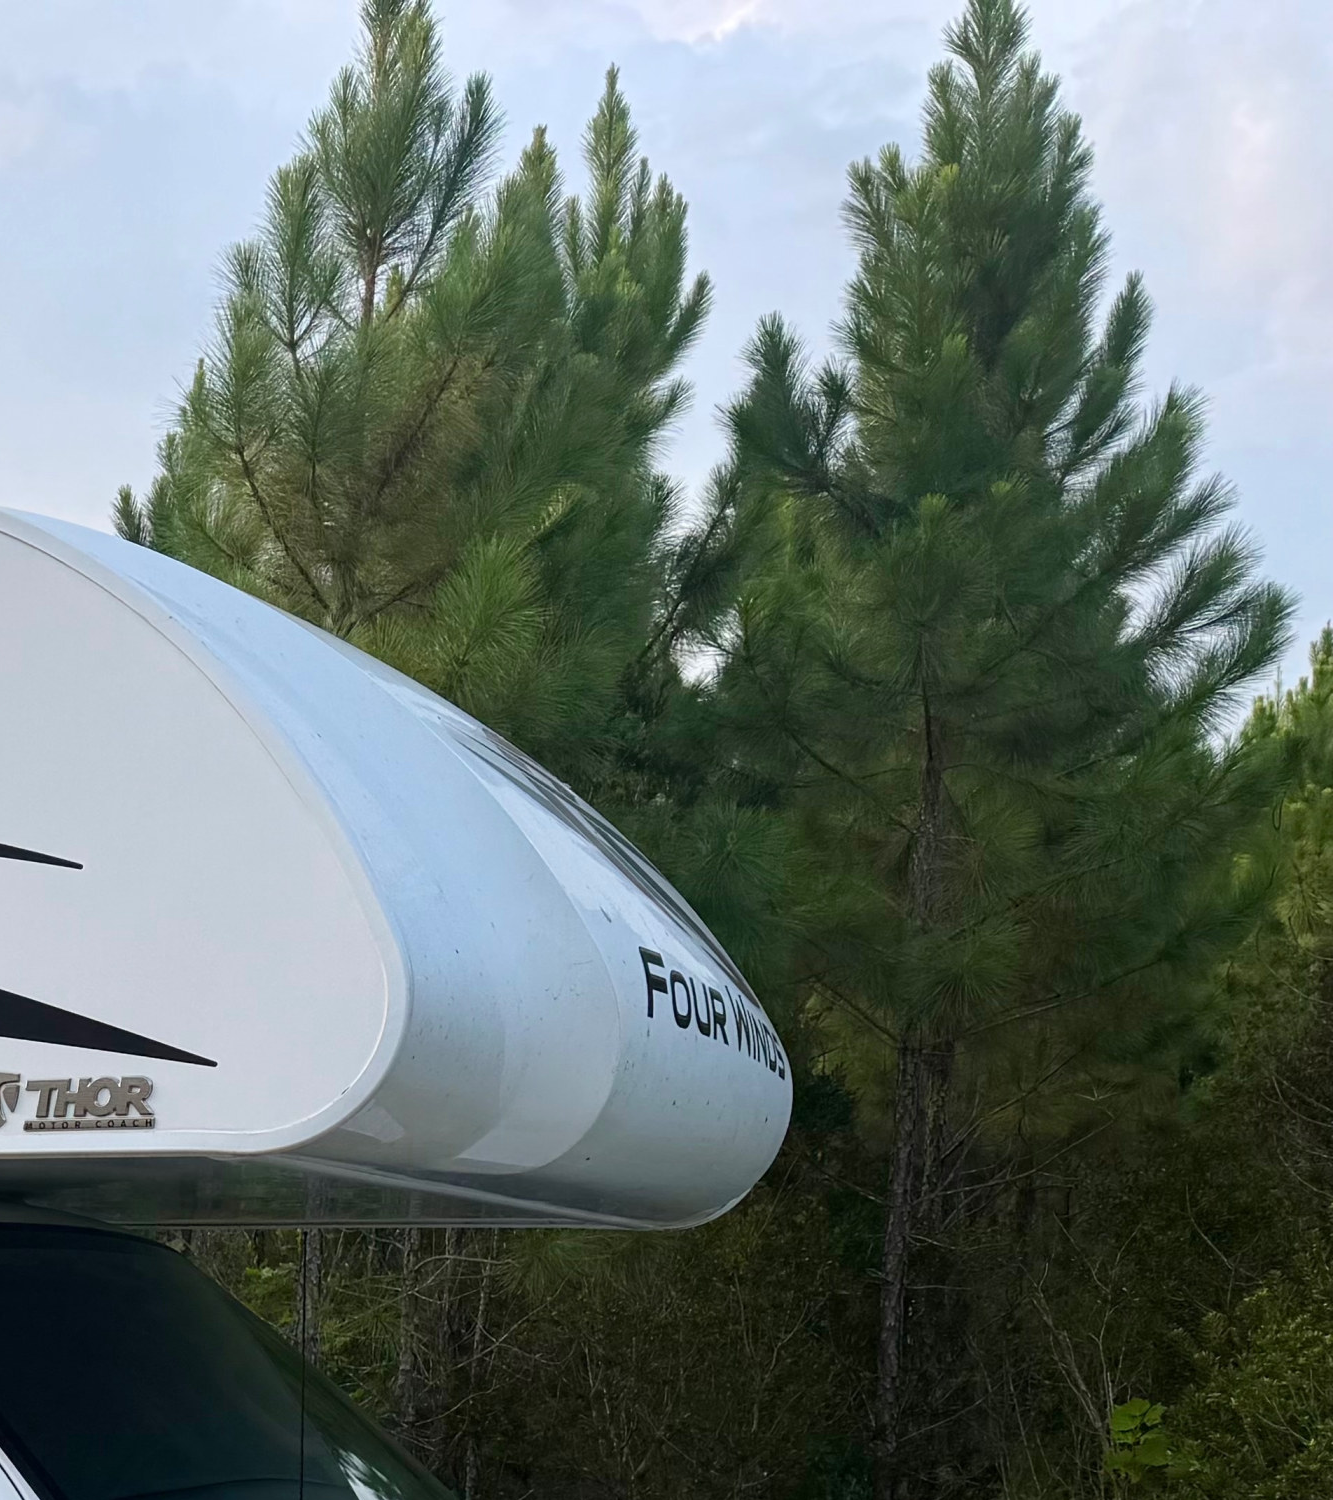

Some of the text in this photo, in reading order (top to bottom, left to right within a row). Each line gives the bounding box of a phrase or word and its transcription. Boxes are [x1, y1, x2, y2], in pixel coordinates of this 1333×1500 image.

[638, 946, 730, 1046] FOUR
[25, 1076, 155, 1119] THOR
[25, 1118, 154, 1131] MOTOR COACH
